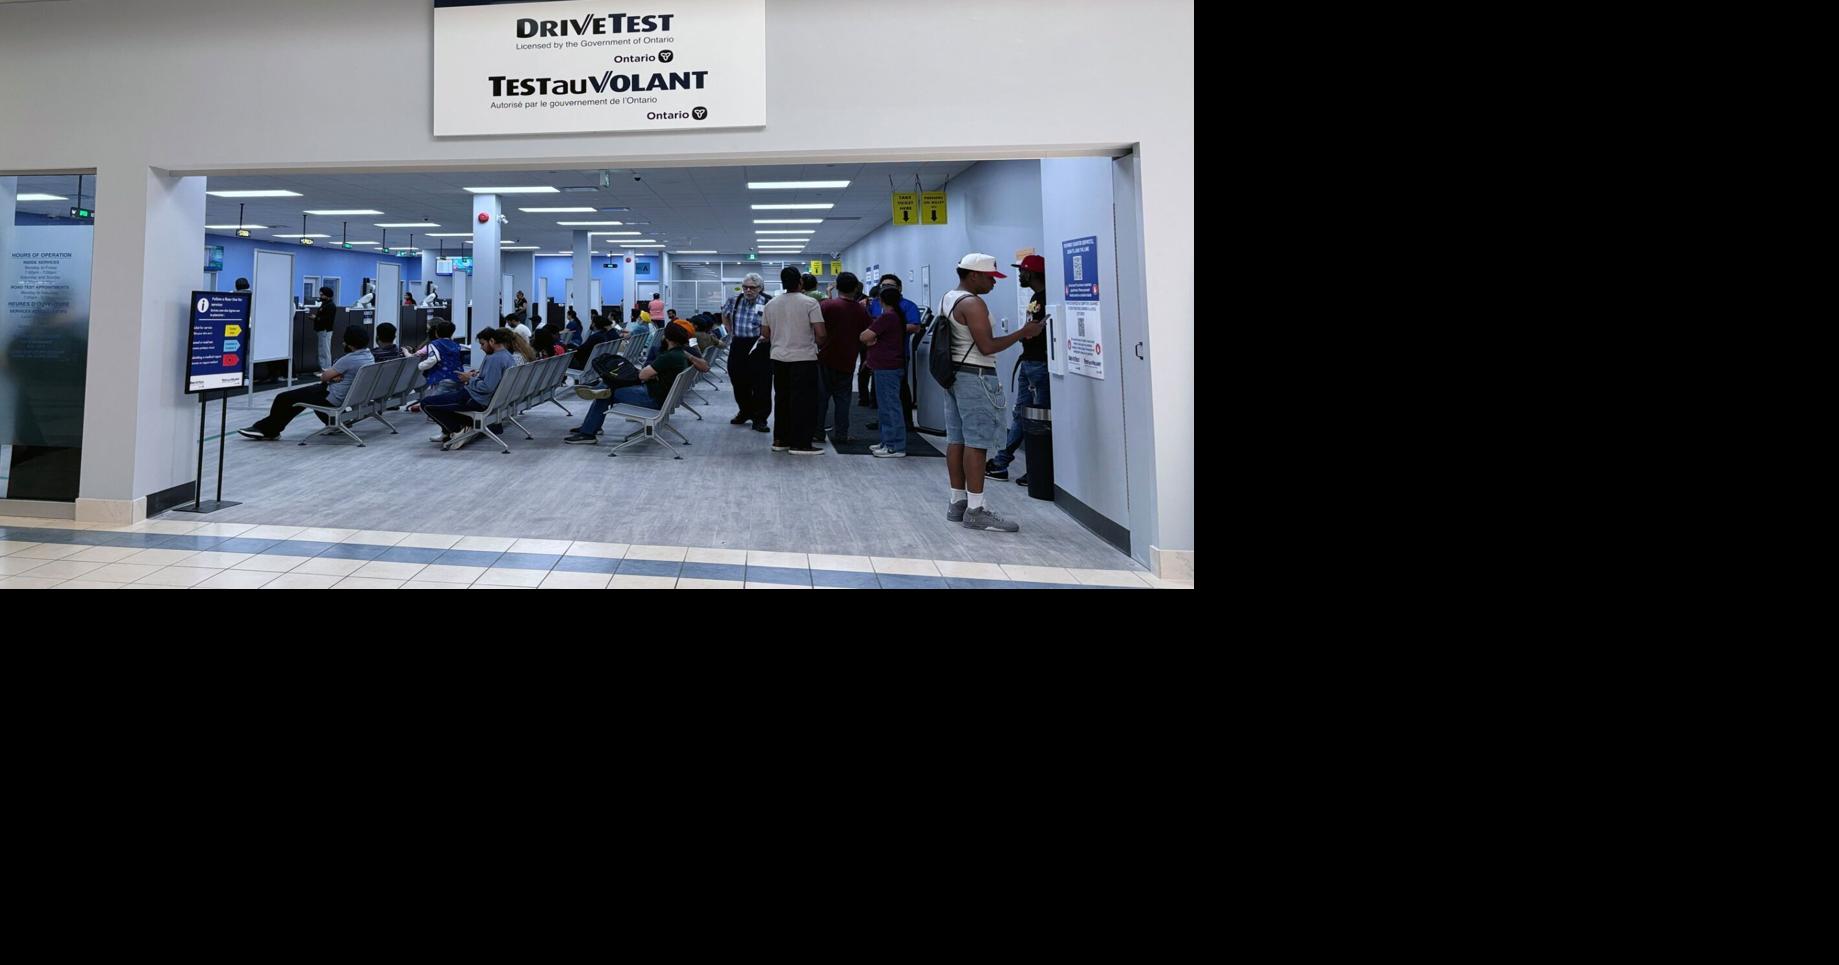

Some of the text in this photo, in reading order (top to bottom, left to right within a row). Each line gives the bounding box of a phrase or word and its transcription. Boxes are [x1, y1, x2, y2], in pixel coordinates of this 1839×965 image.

[515, 41, 552, 50] Licensed
[553, 41, 563, 50] by
[580, 38, 631, 48] Government
[633, 37, 641, 45] of
[643, 36, 674, 44] Ontario
[613, 54, 656, 63] Ontario
[490, 101, 523, 109] Autorisé
[525, 101, 538, 109] par
[549, 98, 608, 109] gouvernement
[609, 97, 620, 105] de
[622, 96, 658, 104] l'Ontario
[646, 110, 690, 120] Ontario
